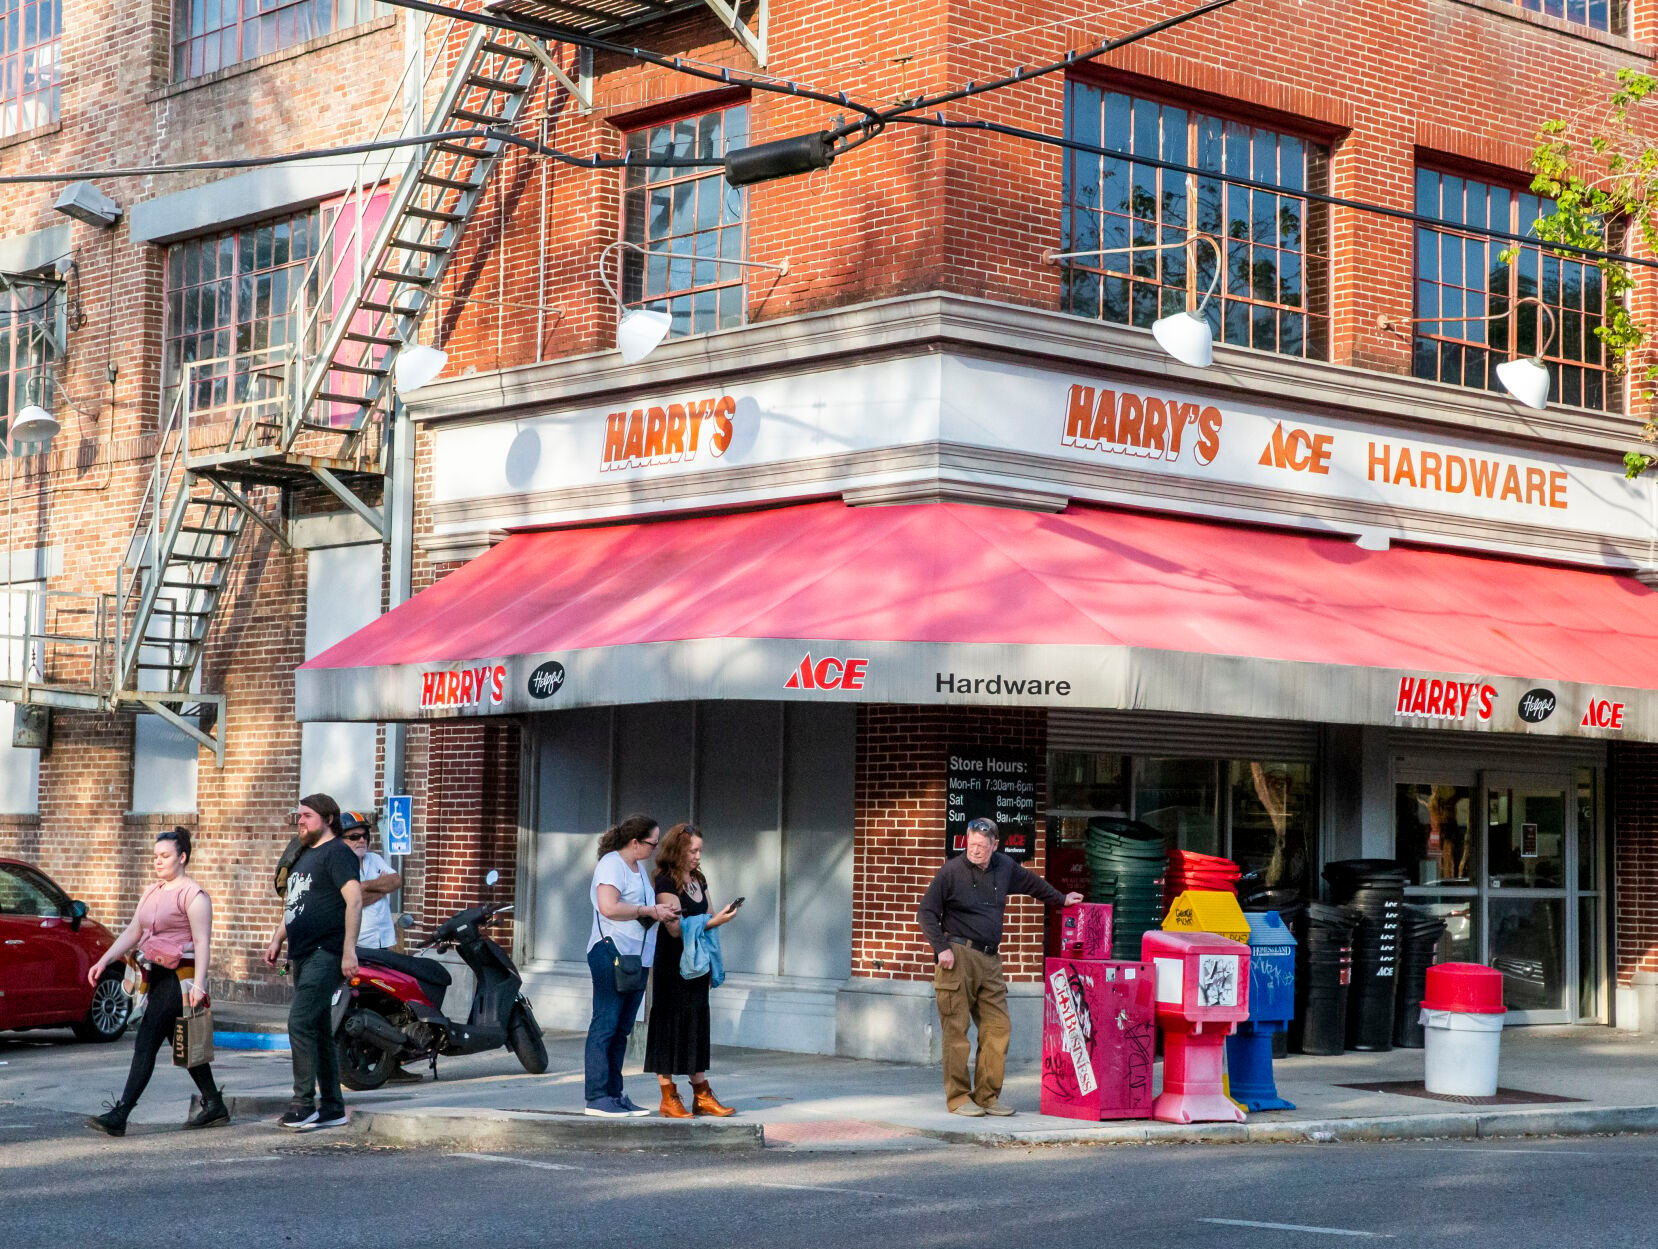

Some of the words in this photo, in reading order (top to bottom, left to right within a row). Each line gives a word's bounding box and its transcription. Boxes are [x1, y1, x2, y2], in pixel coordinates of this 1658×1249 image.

[601, 395, 736, 472] HARRY'S
[1061, 384, 1222, 466] HARRY'S
[1258, 420, 1334, 474] ACE
[1368, 441, 1568, 509] HARDWARE
[420, 665, 506, 709] HARRY'S
[533, 669, 564, 694] Helpful
[783, 651, 869, 690] ACE
[936, 672, 1071, 696] Hardware
[1395, 676, 1498, 722] HARRY'S
[1523, 695, 1555, 719] Helpful
[1580, 696, 1624, 730] ACE
[950, 756, 984, 771] Store
[987, 757, 1028, 773] Hours:
[949, 777, 981, 790] Mon-Fri
[986, 779, 1034, 794] 7:30am-6pm
[949, 794, 964, 806] Sat
[996, 795, 1034, 809] 8am-6pm
[949, 810, 966, 822] Sun
[1376, 966, 1394, 976] ACE
[176, 1024, 185, 1058] LUSH
